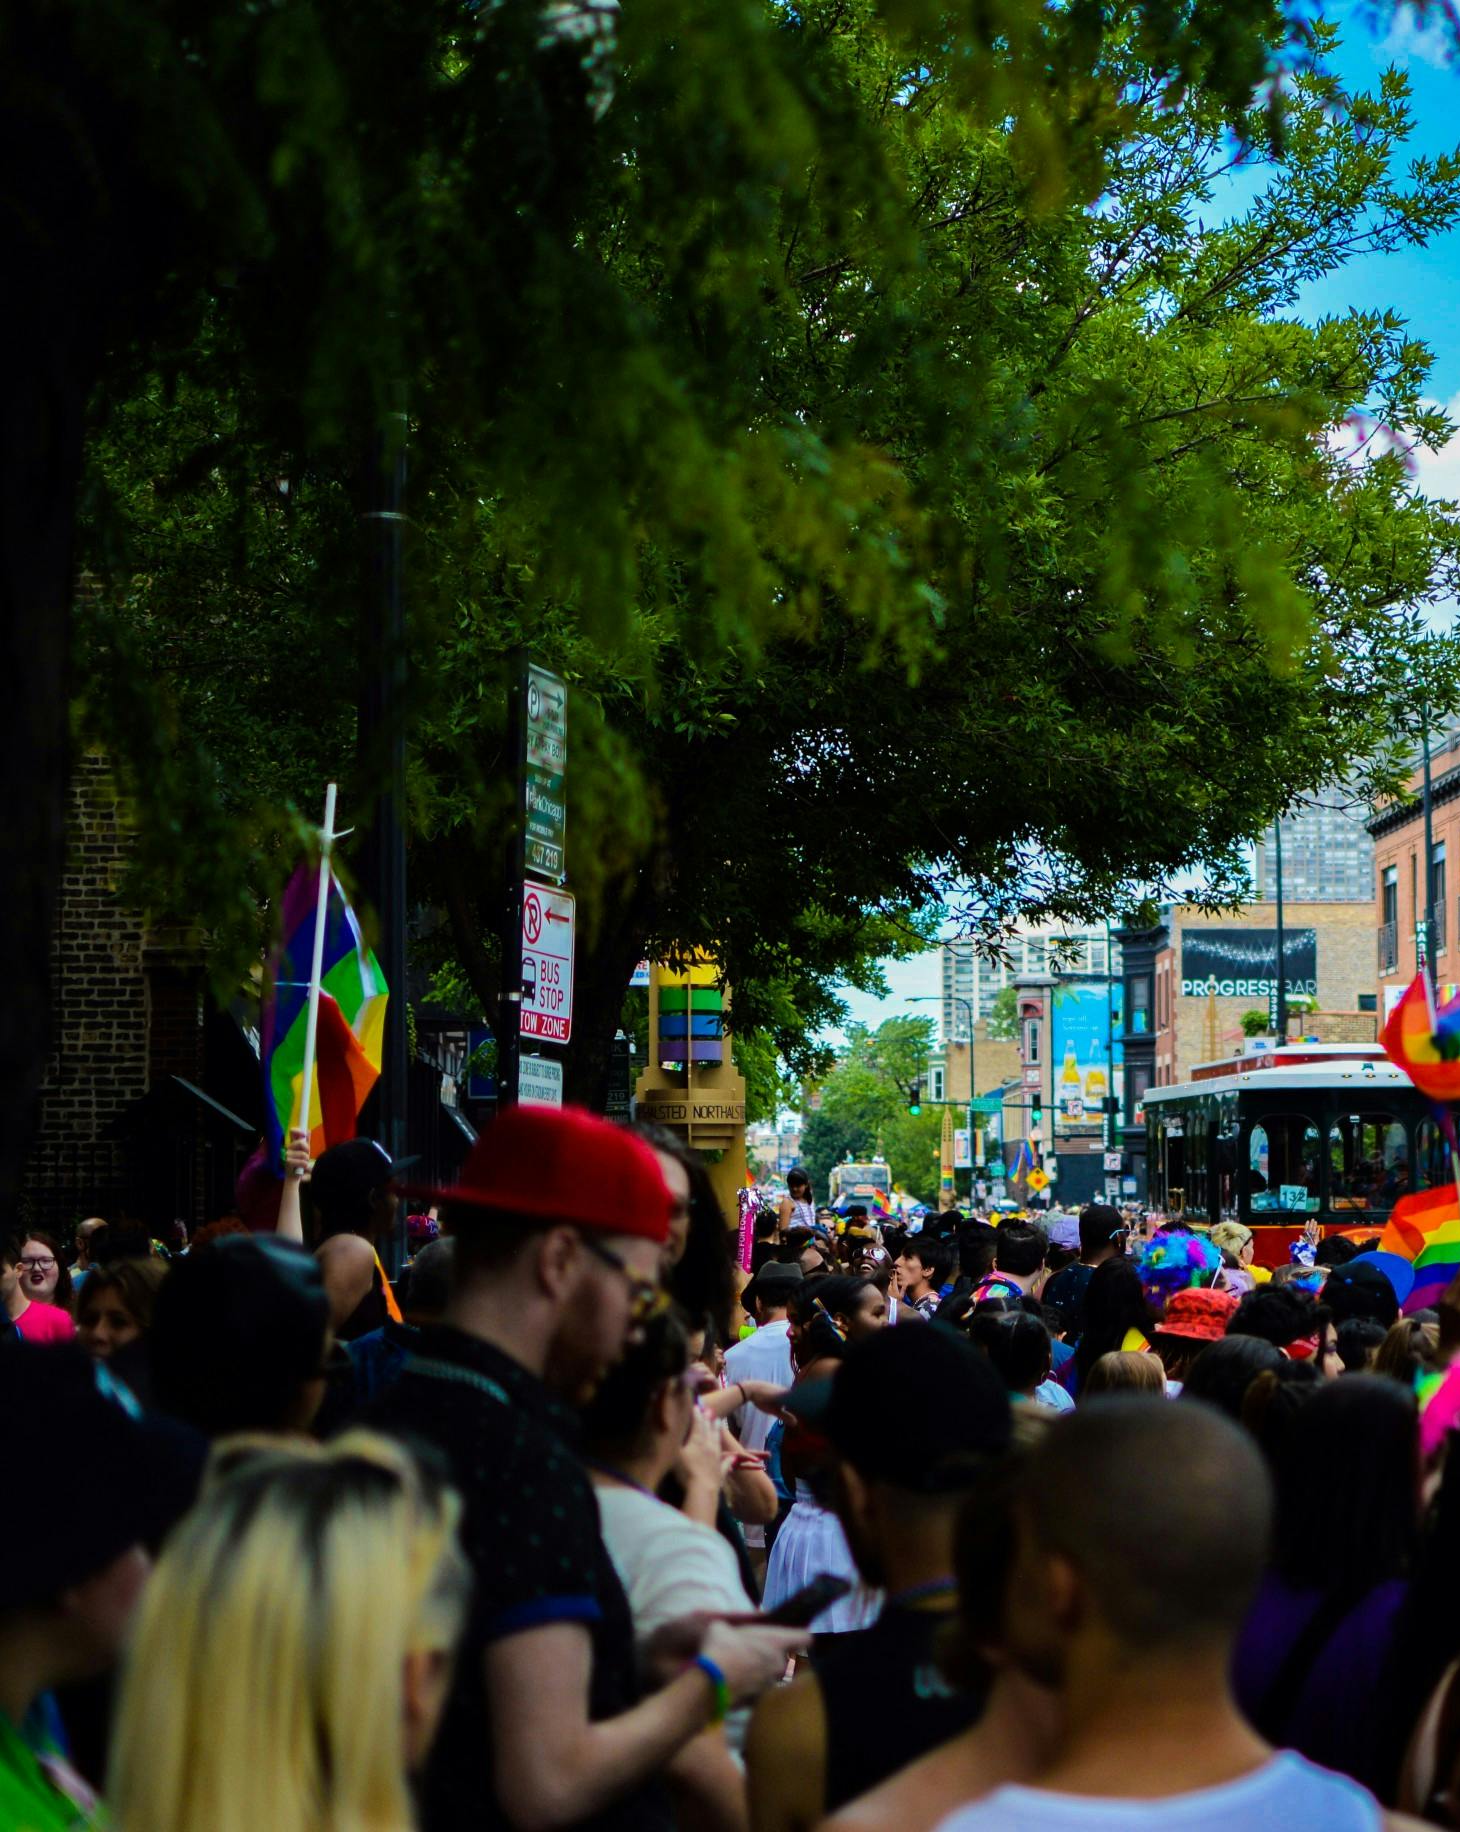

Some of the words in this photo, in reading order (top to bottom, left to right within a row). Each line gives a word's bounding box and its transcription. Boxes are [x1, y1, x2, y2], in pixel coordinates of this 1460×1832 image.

[540, 960, 560, 985] BUS
[540, 986, 564, 1011] STOP
[1181, 979, 1271, 997] PROGRES
[520, 1011, 538, 1033] TOW
[541, 1016, 566, 1037] ZONE
